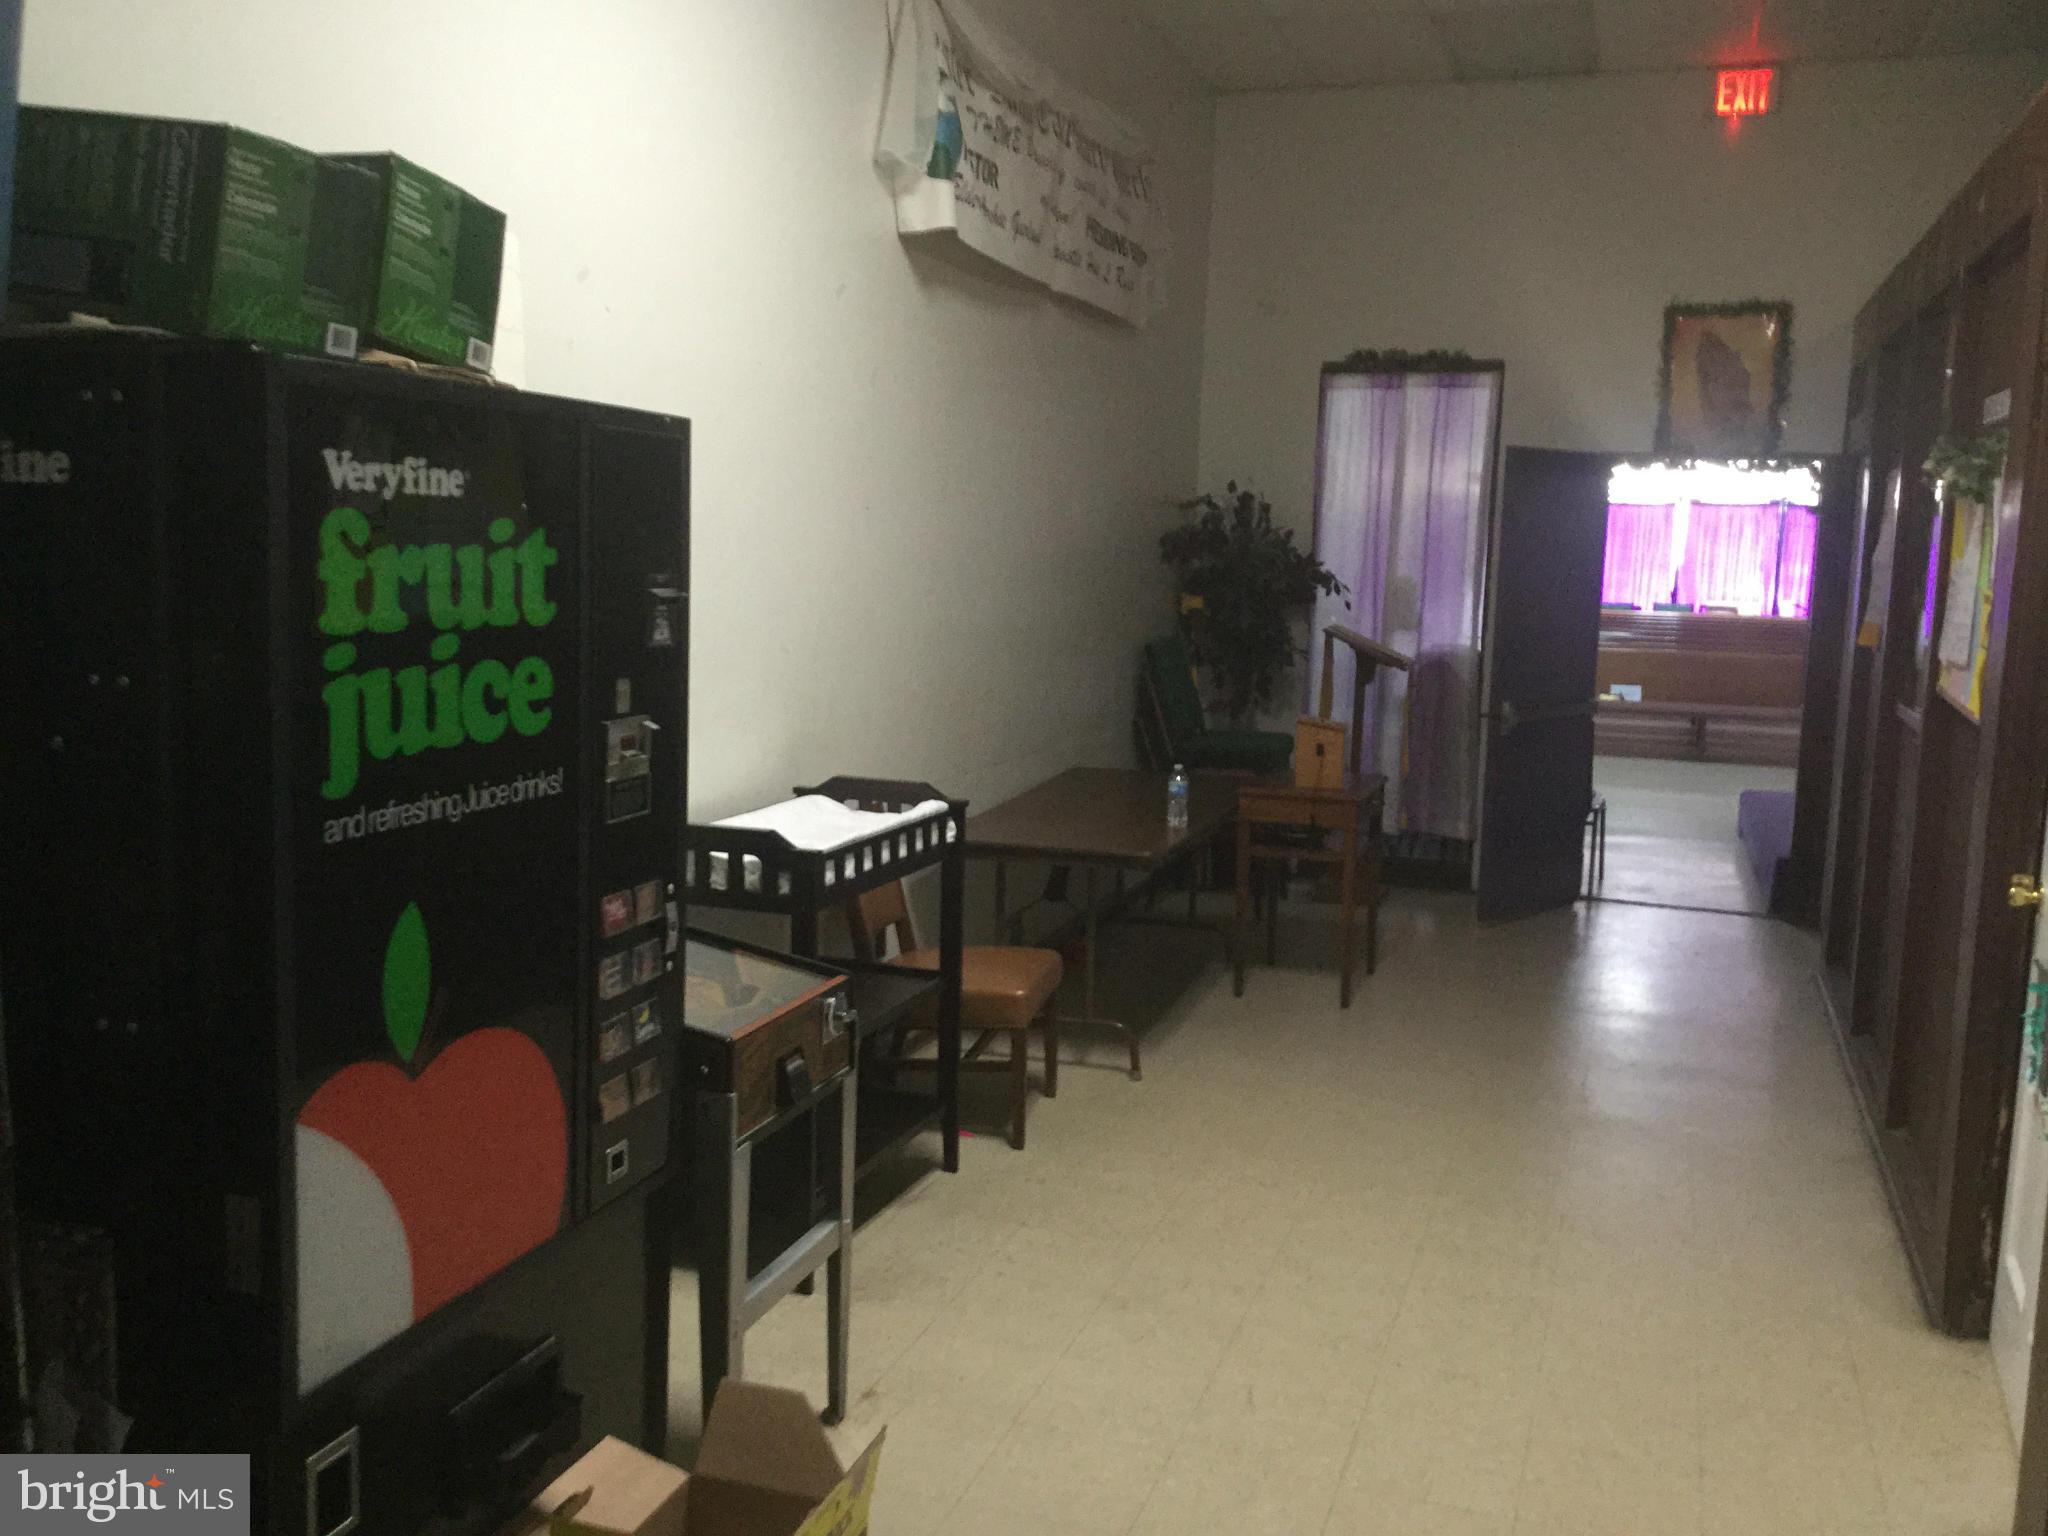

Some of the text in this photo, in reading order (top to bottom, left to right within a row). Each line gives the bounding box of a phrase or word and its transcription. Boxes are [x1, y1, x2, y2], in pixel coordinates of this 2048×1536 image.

[1716, 69, 1773, 114] EXIT
[324, 447, 464, 500] Veryfine
[318, 507, 558, 636] fruit
[321, 632, 554, 800] juice
[324, 805, 366, 844] and
[367, 791, 462, 834] refreshing
[509, 766, 564, 803] drinks!
